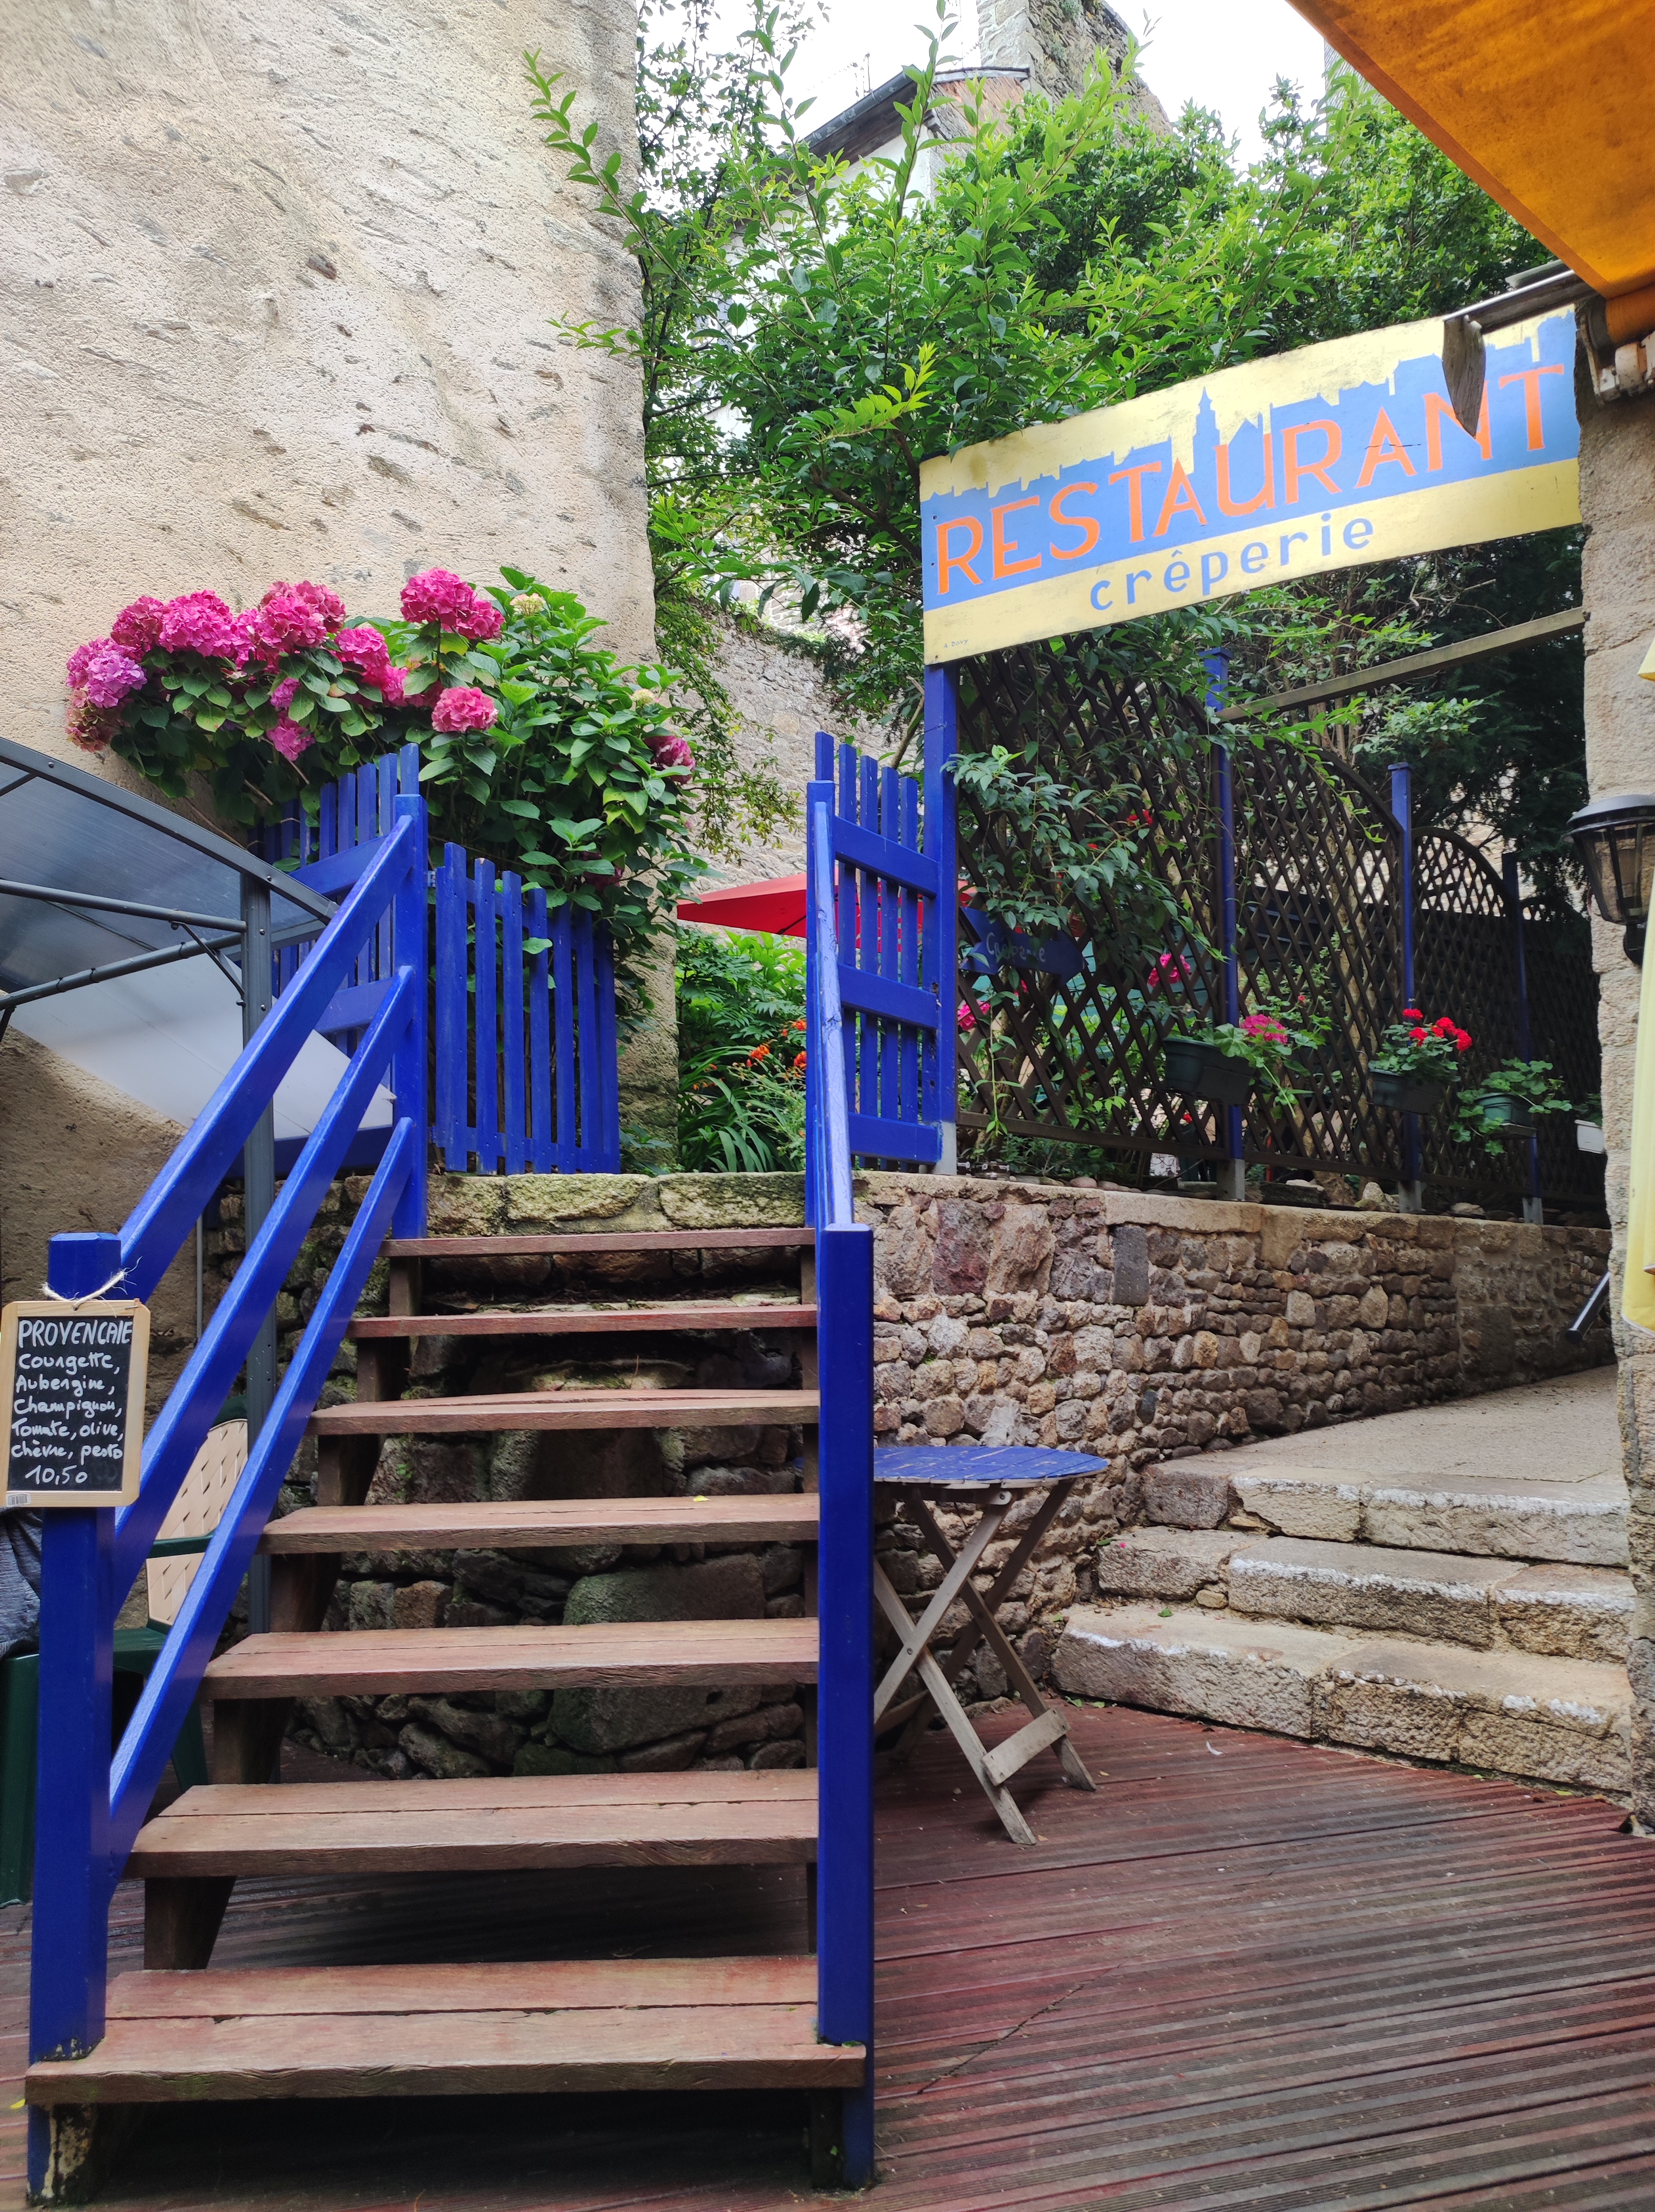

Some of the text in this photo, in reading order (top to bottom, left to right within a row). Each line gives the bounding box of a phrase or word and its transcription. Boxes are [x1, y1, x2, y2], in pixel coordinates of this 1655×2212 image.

[936, 363, 1564, 596] RESTAURANT
[1089, 512, 1373, 611] crêperie
[25, 1464, 88, 1485] 10,50
[81, 1444, 123, 1465] pesto
